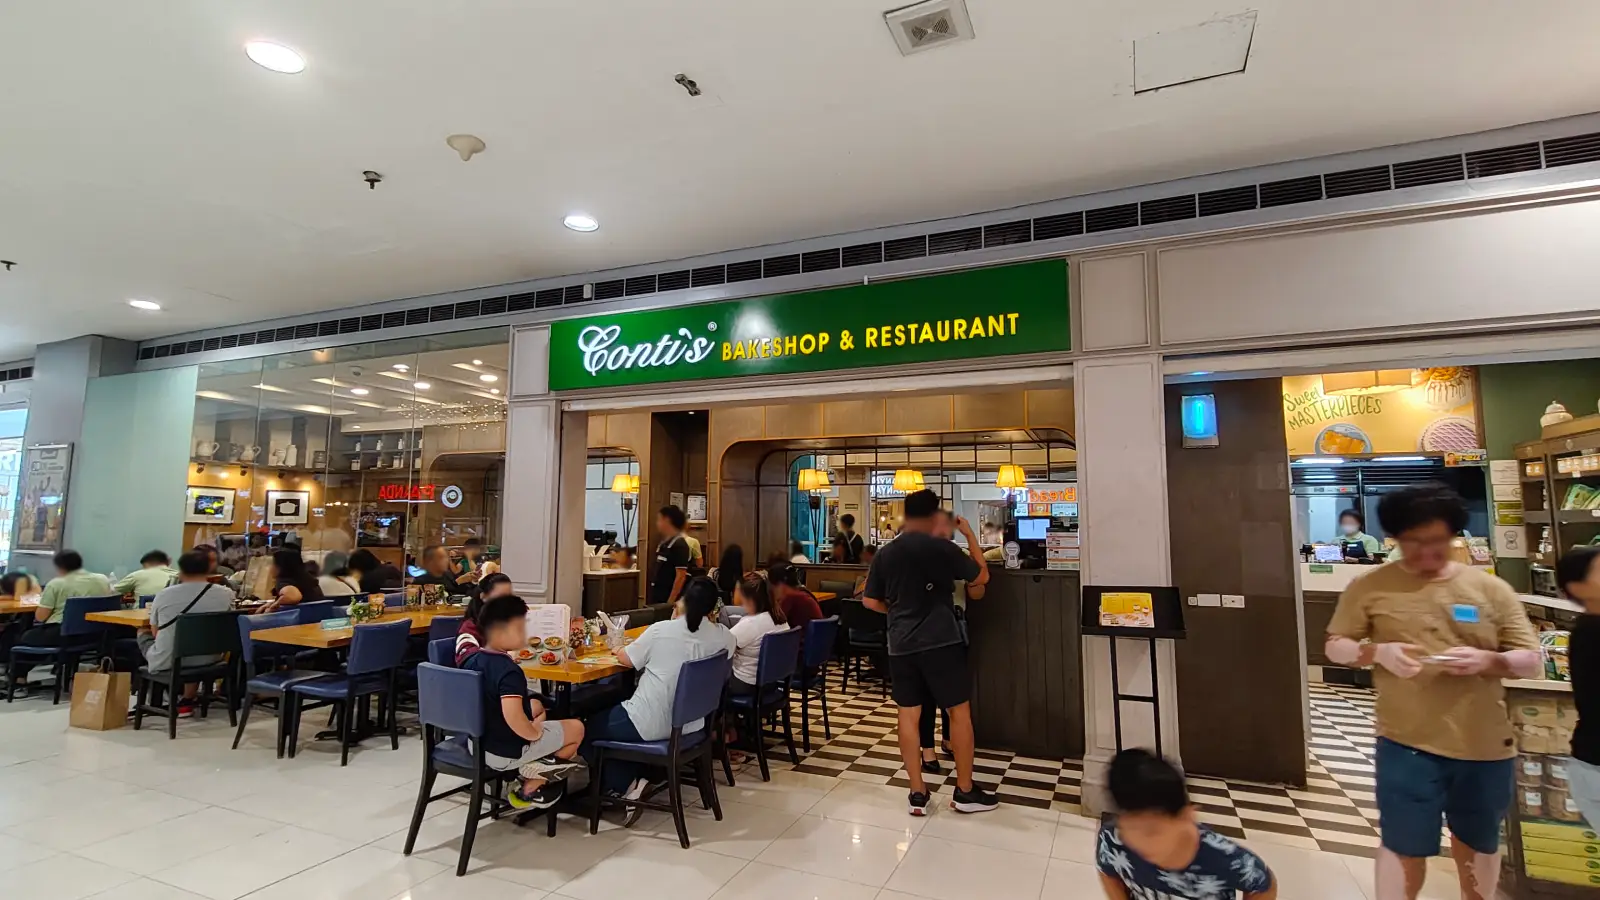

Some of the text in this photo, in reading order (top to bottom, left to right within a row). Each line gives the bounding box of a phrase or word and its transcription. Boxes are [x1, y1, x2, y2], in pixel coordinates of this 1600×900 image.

[578, 325, 715, 376] Conti's
[722, 313, 1020, 361] BAKESHOP & RESTAURANT
[1288, 394, 1383, 430] MASTERPIECES
